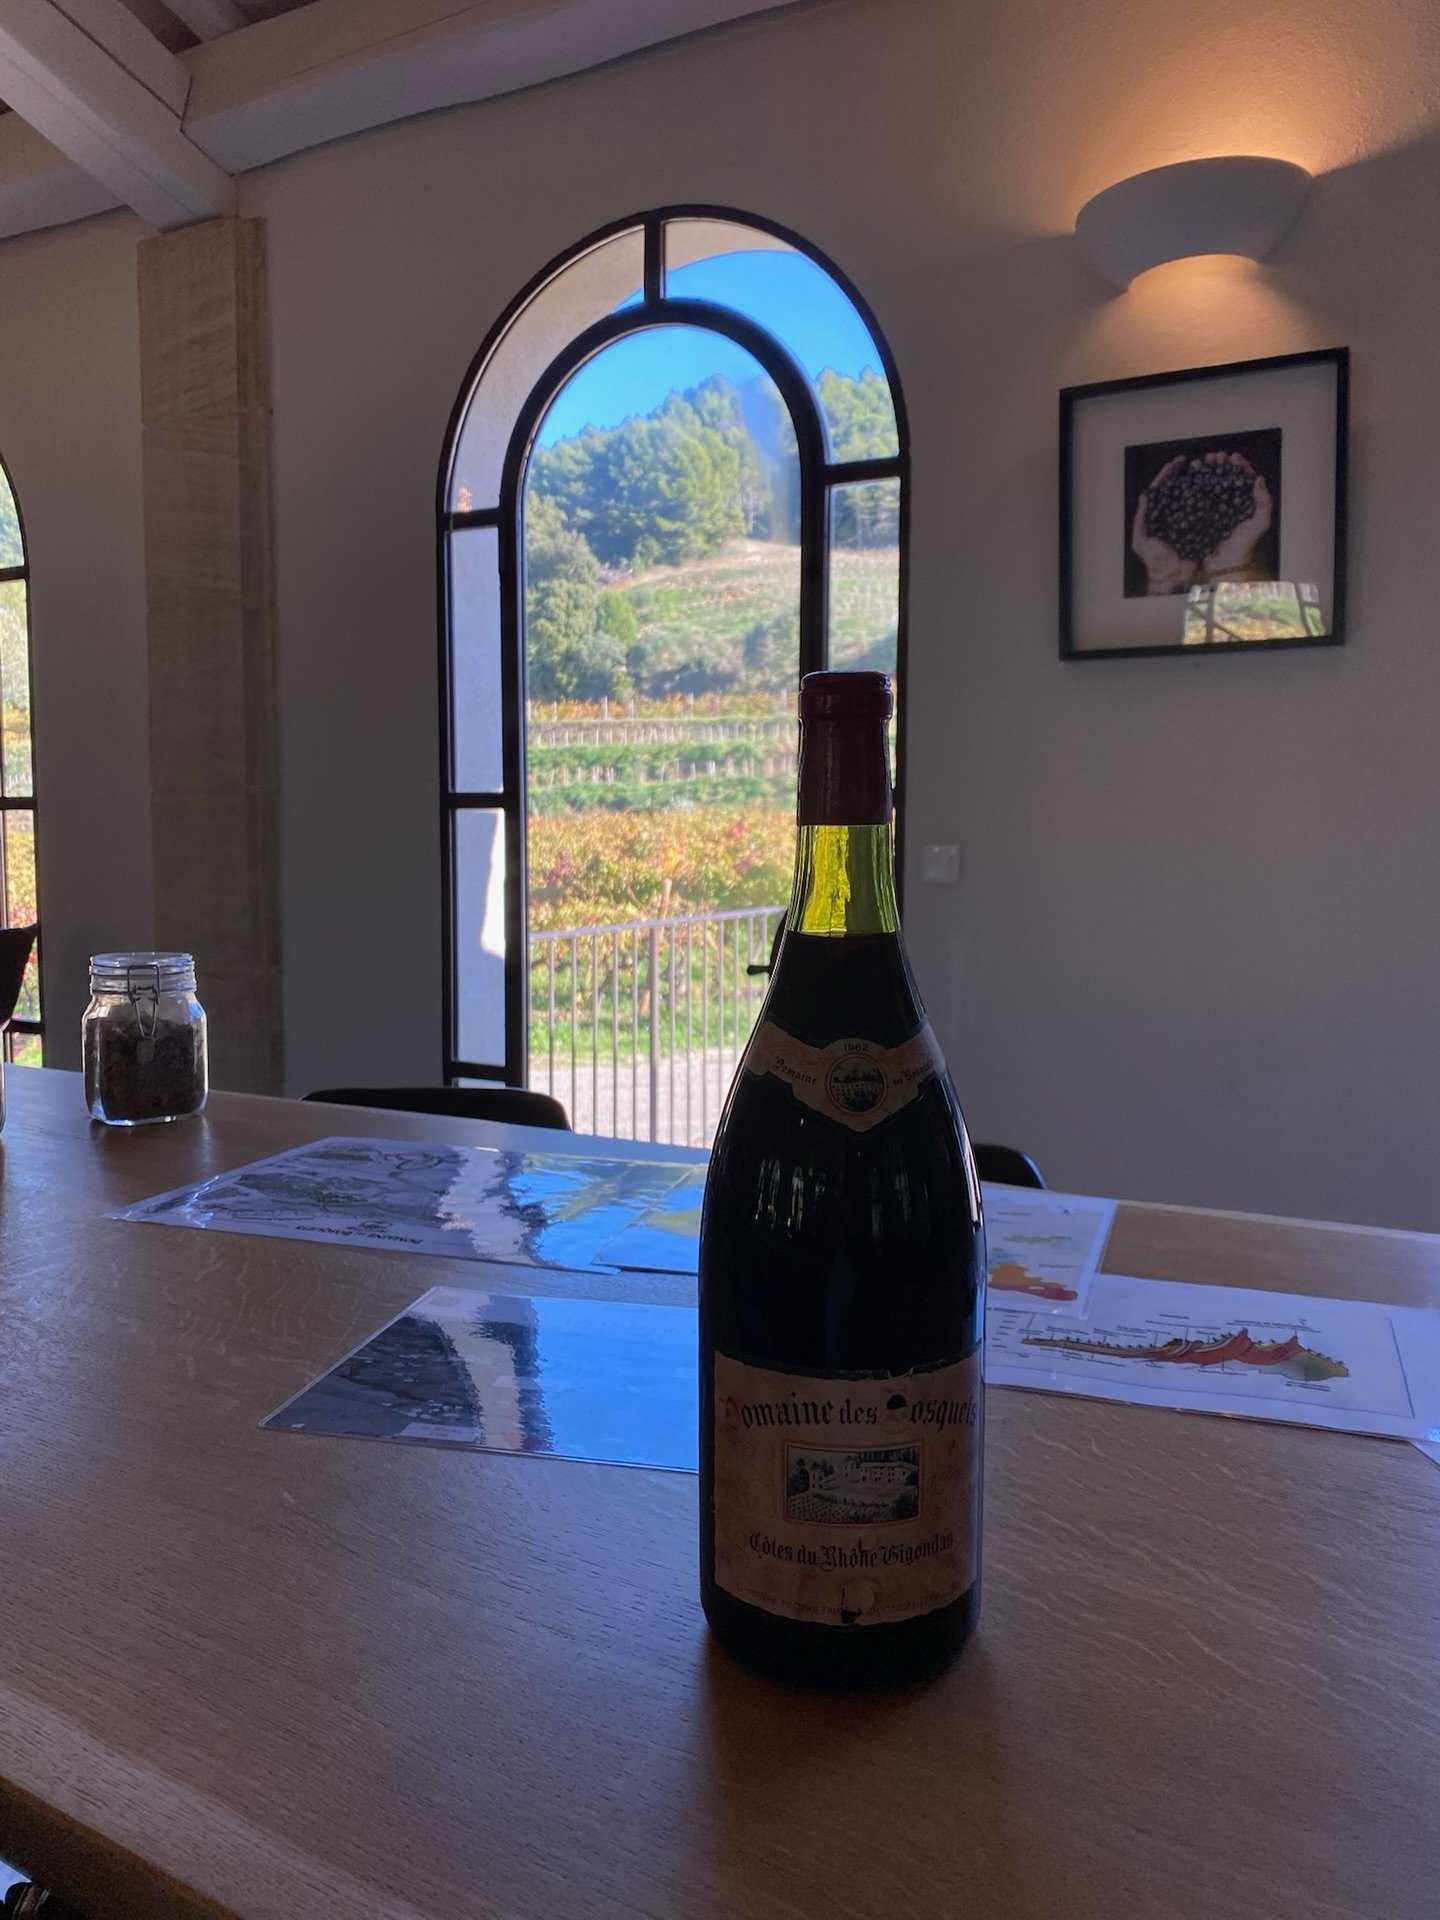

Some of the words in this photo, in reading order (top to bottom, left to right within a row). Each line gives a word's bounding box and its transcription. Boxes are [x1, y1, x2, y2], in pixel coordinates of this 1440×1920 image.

[839, 1398, 877, 1426] des
[797, 1544, 818, 1566] du
[879, 1532, 954, 1566] Gigondas
